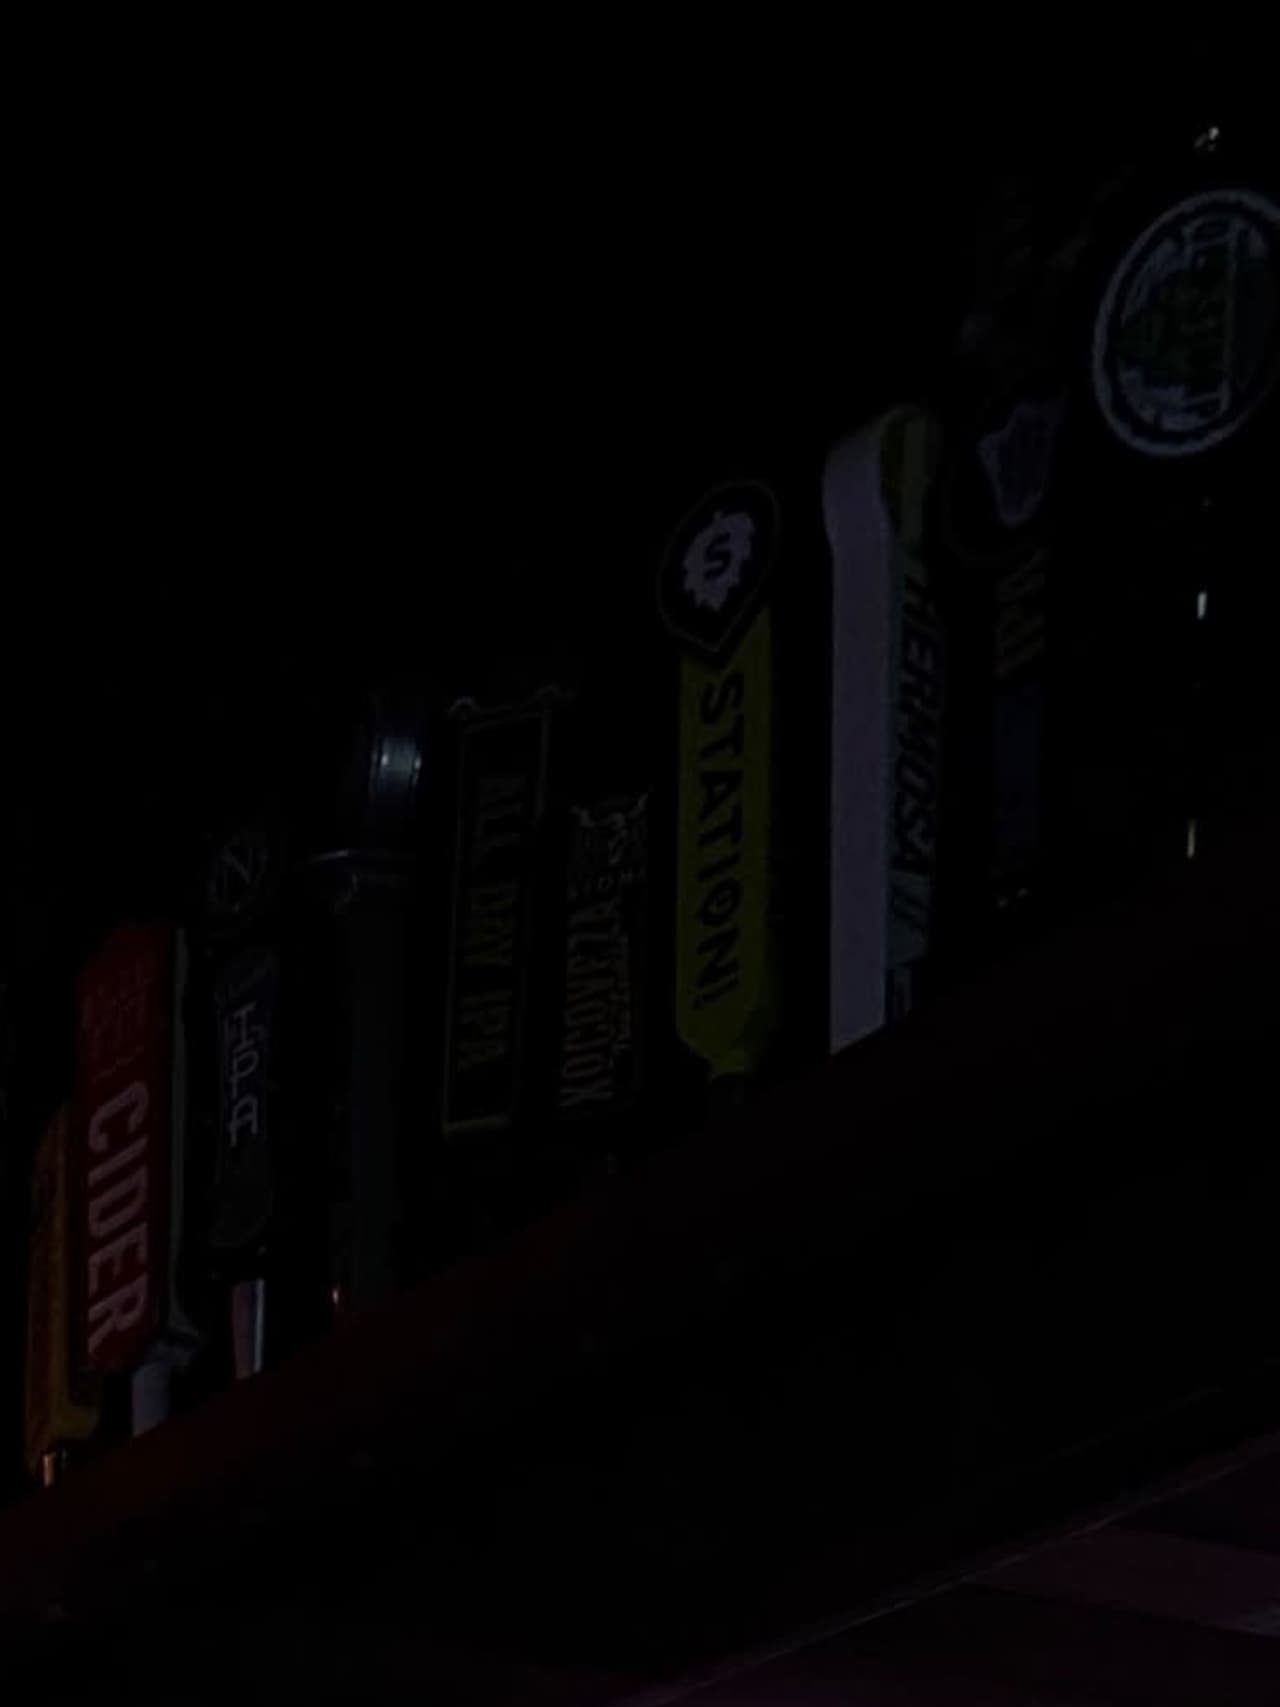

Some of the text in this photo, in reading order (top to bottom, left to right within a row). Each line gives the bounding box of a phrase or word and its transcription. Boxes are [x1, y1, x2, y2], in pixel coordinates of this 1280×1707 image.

[693, 670, 743, 1010] STATION
[227, 1000, 261, 1149] IPA
[87, 1079, 151, 1356] CIDER
